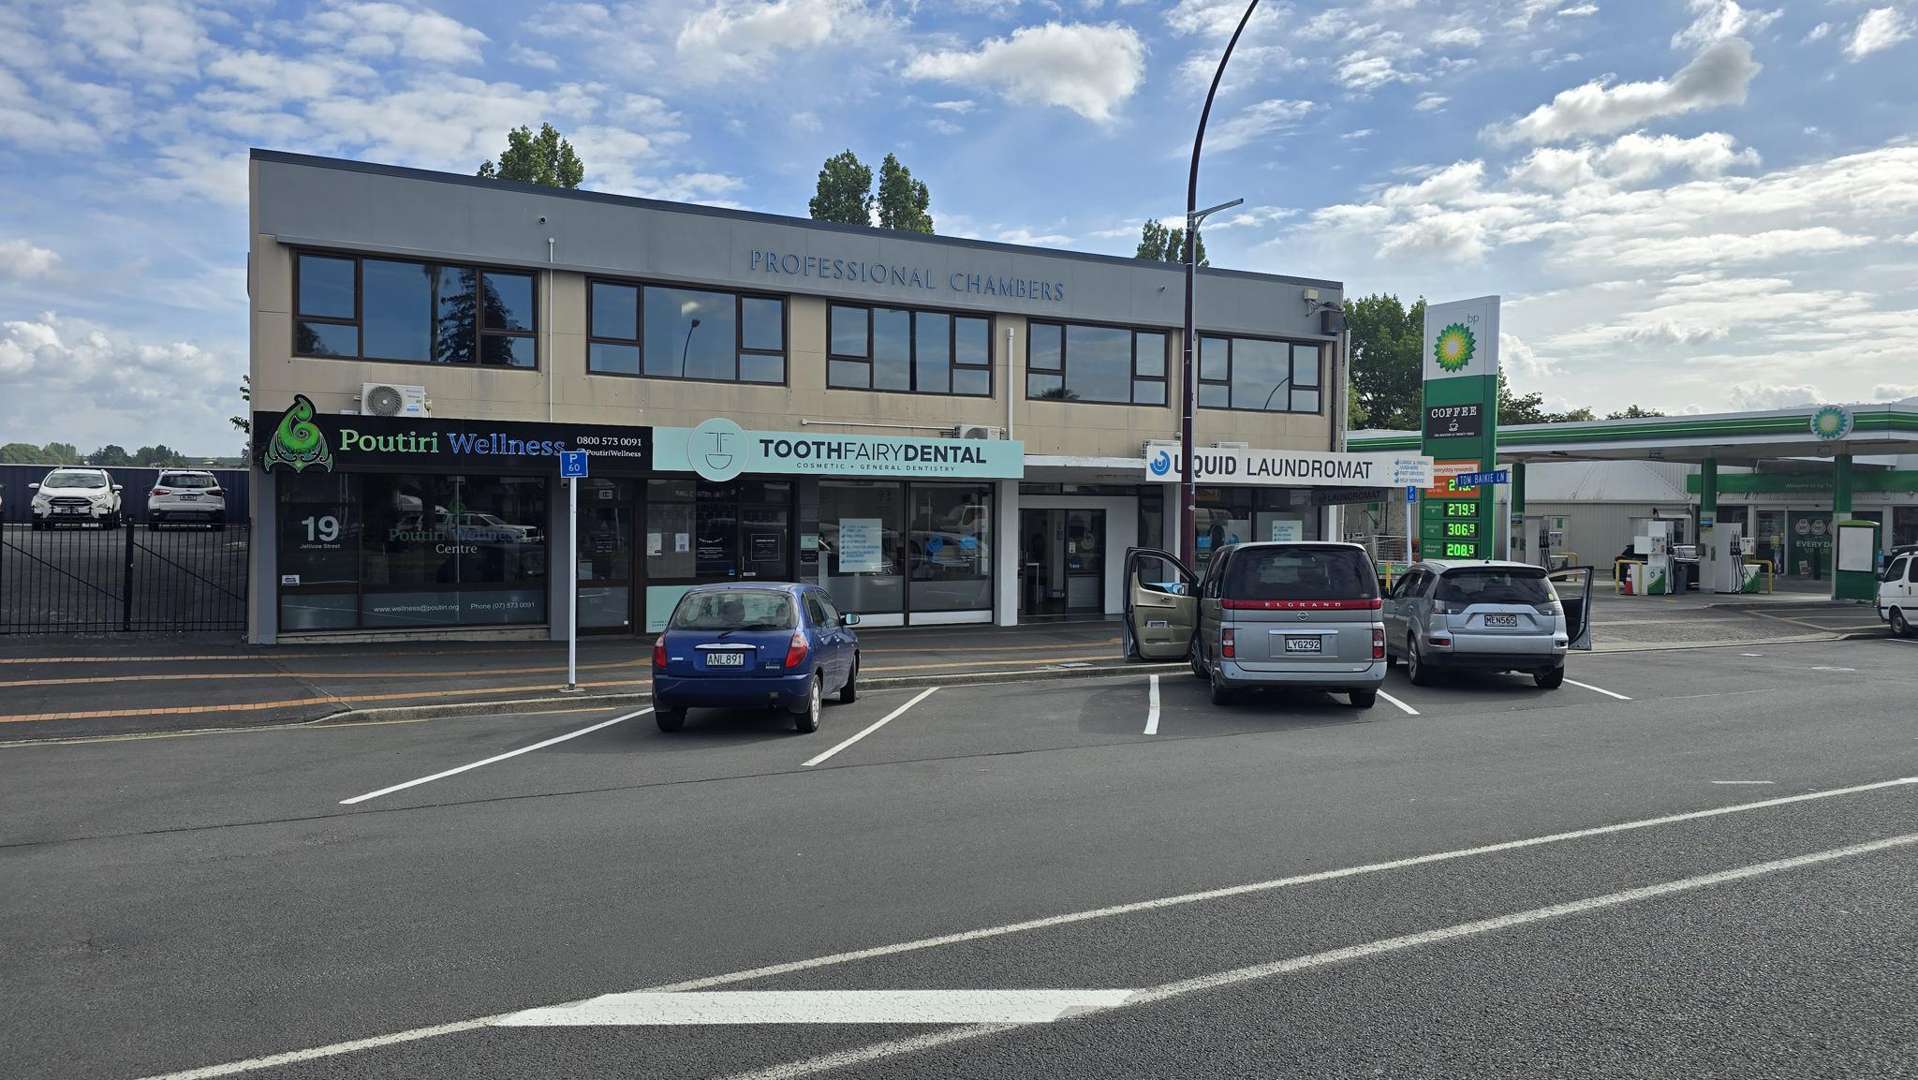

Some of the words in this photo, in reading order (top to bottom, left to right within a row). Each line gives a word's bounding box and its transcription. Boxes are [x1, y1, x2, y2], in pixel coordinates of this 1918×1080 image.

[751, 249, 937, 290] PROFESSIONAL
[951, 271, 1064, 301] CHAMBERS
[1466, 313, 1480, 324] bp
[1431, 406, 1477, 418] COFFEE
[339, 428, 440, 454] Poutiri
[447, 432, 565, 456] Wellness
[576, 436, 601, 445] 0800
[602, 437, 619, 446] 573
[620, 438, 642, 447] 0091
[759, 438, 987, 464] TOOTHFAIRYDENTAL
[569, 453, 578, 464] P
[568, 463, 581, 472] 60
[797, 462, 846, 470] COSMETIC
[906, 464, 956, 472] DENTISTRY
[1174, 454, 1237, 478] LQUID
[1246, 457, 1373, 480] LAUNDROMAT
[1460, 475, 1472, 486] TOM
[1497, 471, 1506, 481] LN
[1448, 504, 1475, 516] 279.9
[302, 516, 339, 541] 19
[1448, 524, 1475, 536] 306.9
[435, 543, 478, 554] Centre
[1447, 544, 1474, 557] 208.9
[1486, 615, 1516, 625] MEN565
[1287, 638, 1320, 650] LYG292
[707, 653, 743, 666] ANL891
